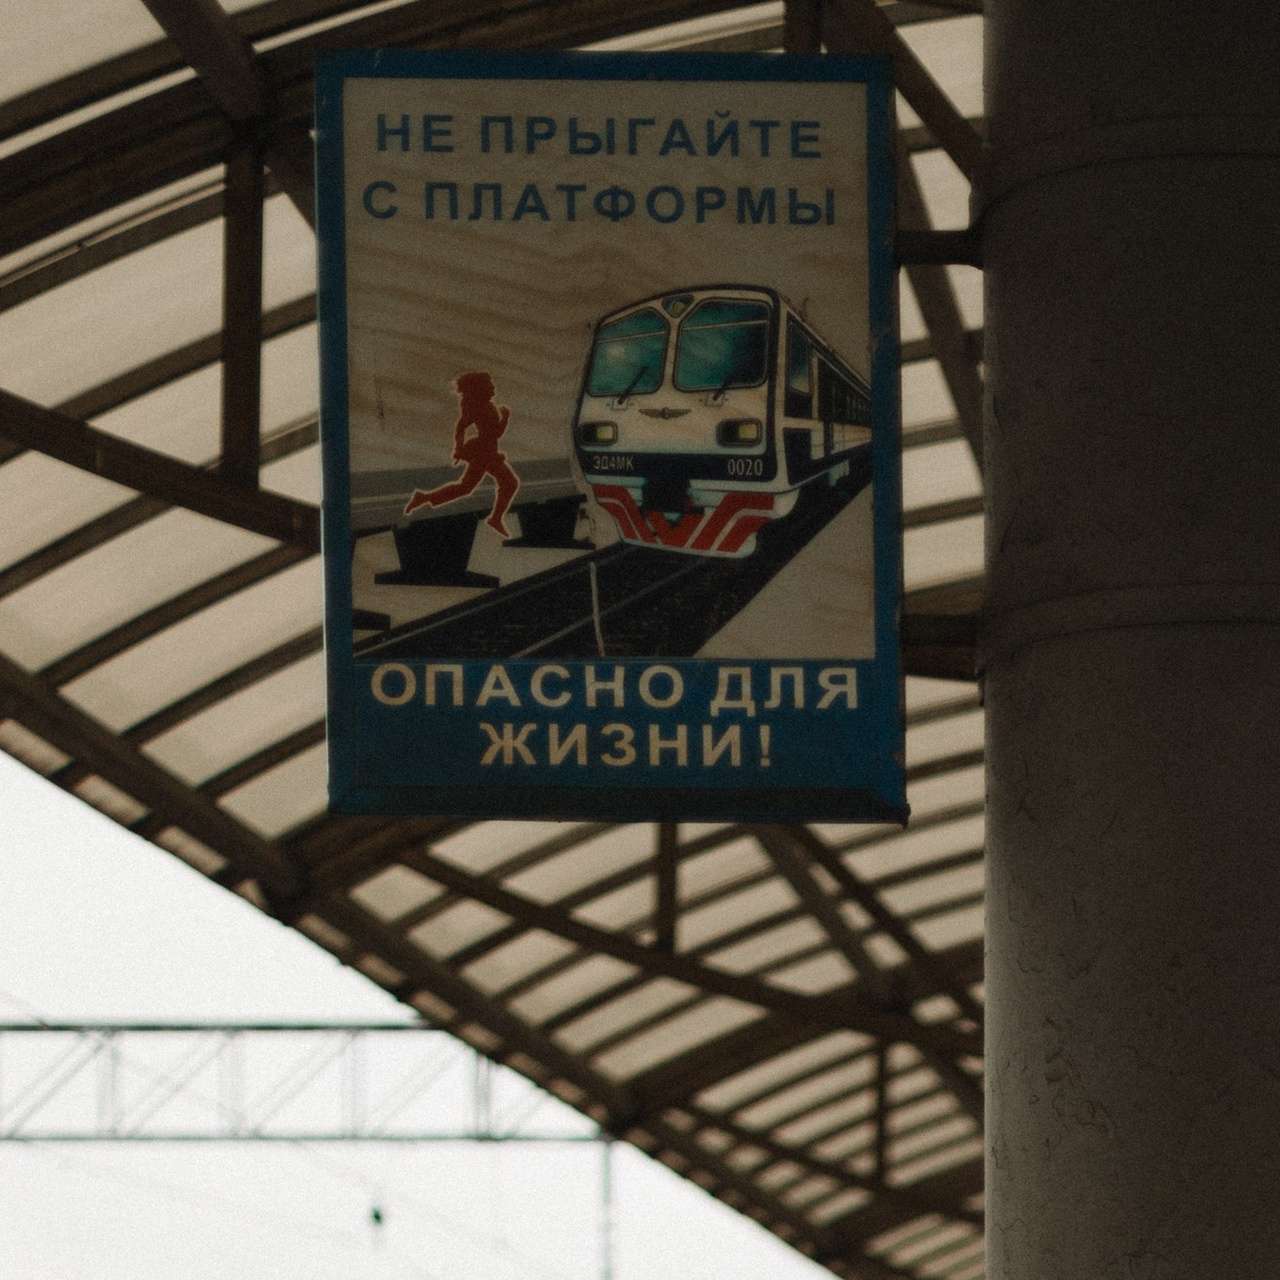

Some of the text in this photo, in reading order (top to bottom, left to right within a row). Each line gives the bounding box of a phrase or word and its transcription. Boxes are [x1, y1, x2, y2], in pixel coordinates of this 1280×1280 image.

[376, 110, 823, 158] НЕ ПРЫГАЙТЕ
[362, 180, 836, 225] С ПЛАТФОРМЫ
[727, 458, 763, 476] 0020
[371, 663, 858, 717] ОПАСНО ДЛЯ
[479, 722, 772, 767] ЖИЗНИ!
